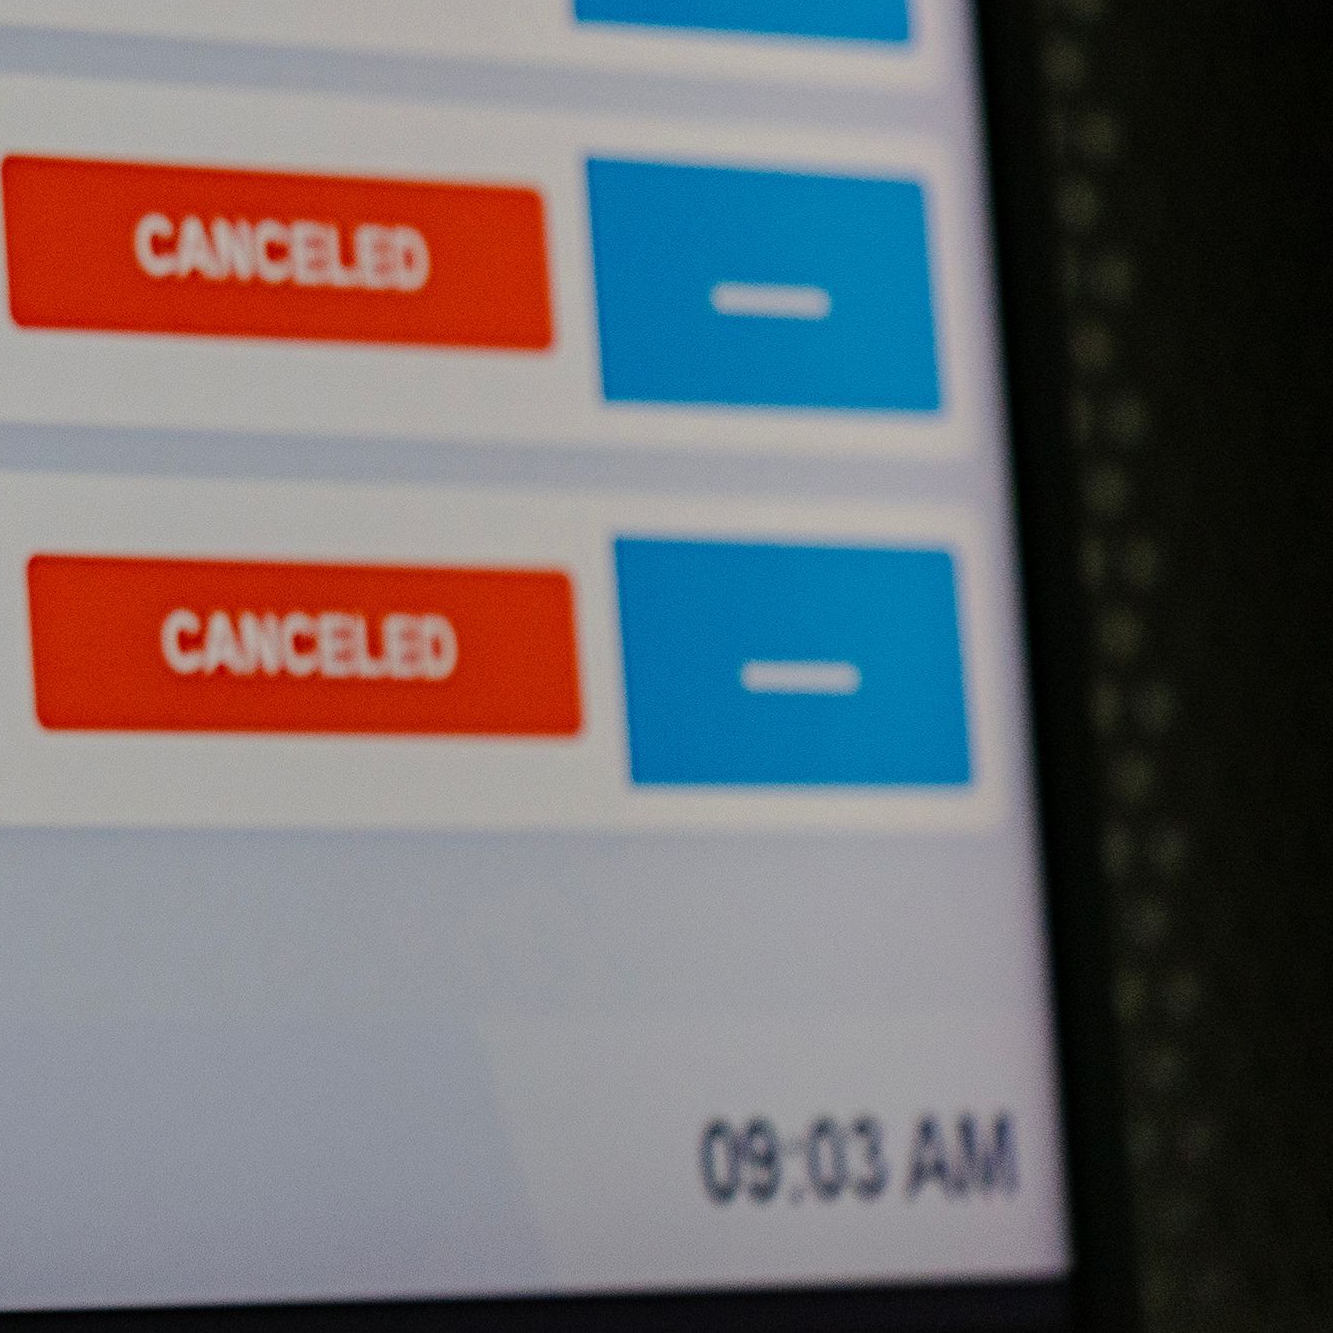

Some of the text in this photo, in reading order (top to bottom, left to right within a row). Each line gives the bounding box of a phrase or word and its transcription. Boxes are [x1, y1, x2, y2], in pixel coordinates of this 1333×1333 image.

[134, 213, 430, 292] CANCELED
[161, 609, 458, 680] CANCELED
[698, 1110, 1021, 1206] 09:03 AM
